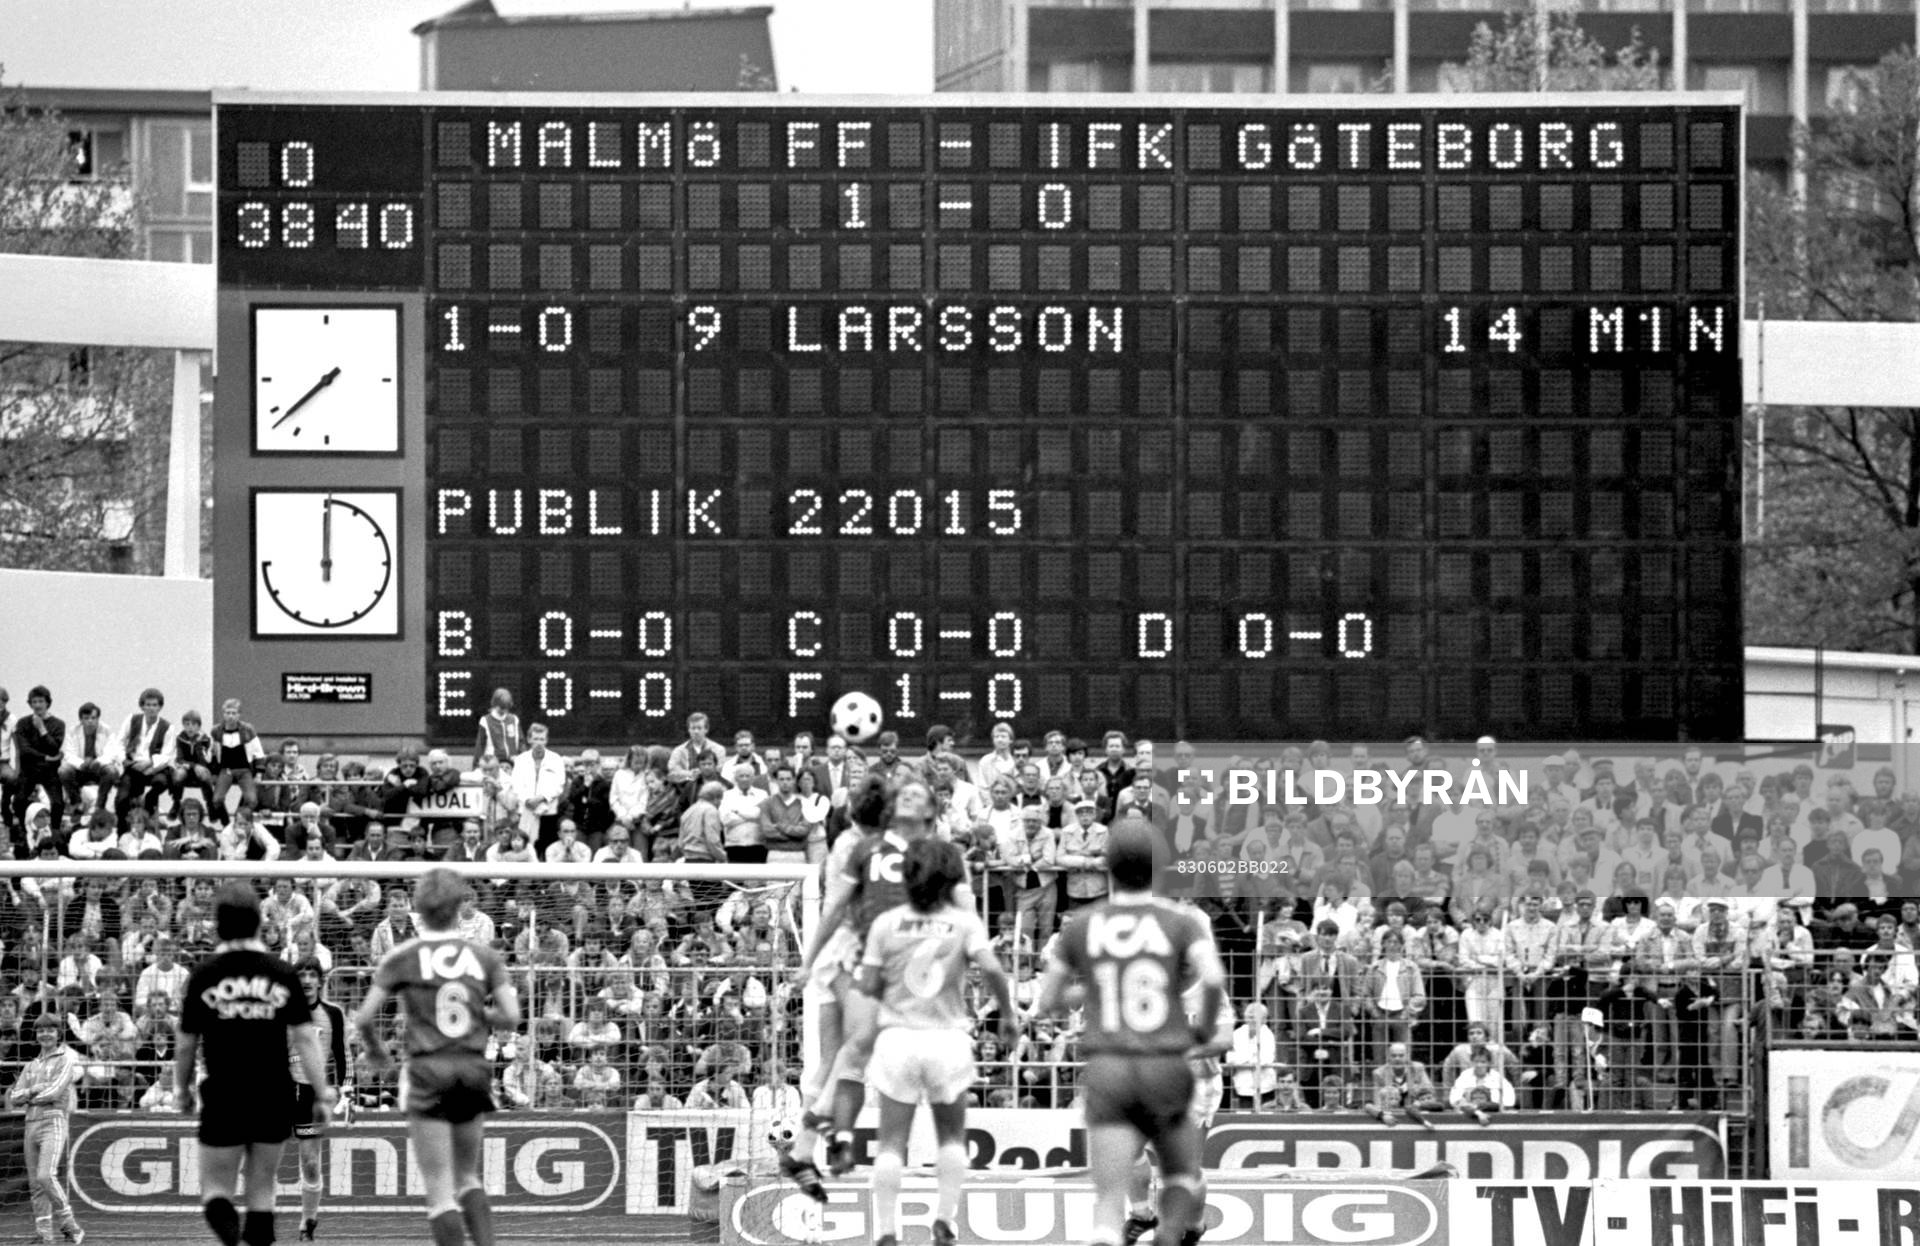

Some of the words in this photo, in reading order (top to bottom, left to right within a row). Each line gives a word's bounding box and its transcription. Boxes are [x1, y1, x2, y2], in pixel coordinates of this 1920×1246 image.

[282, 141, 314, 187] 0
[788, 122, 871, 167] FF
[1051, 123, 1172, 168] IFK
[238, 203, 314, 248] 38
[337, 203, 413, 249] 40
[844, 183, 866, 229] 1
[1039, 184, 1071, 229] 0
[445, 306, 572, 351] 1-0
[689, 307, 721, 351] 9
[789, 307, 1123, 353] LARSSON
[1444, 307, 1522, 353] 14
[438, 489, 721, 535] PUBLIK
[789, 490, 1022, 535] 22015
[438, 611, 472, 656] B
[540, 611, 672, 657] 0-0
[789, 612, 822, 657] C
[889, 612, 1022, 657] 0-0
[1139, 613, 1172, 658] D
[1239, 613, 1372, 658] 0-0
[438, 672, 472, 717] E
[540, 672, 672, 718] 0-0
[789, 673, 822, 718] F
[895, 673, 1022, 718] 1-0
[869, 852, 905, 883] IC
[1087, 911, 1175, 959] ICA
[418, 944, 485, 980] ICA
[435, 981, 471, 1038] 6
[1092, 957, 1170, 1033] 16
